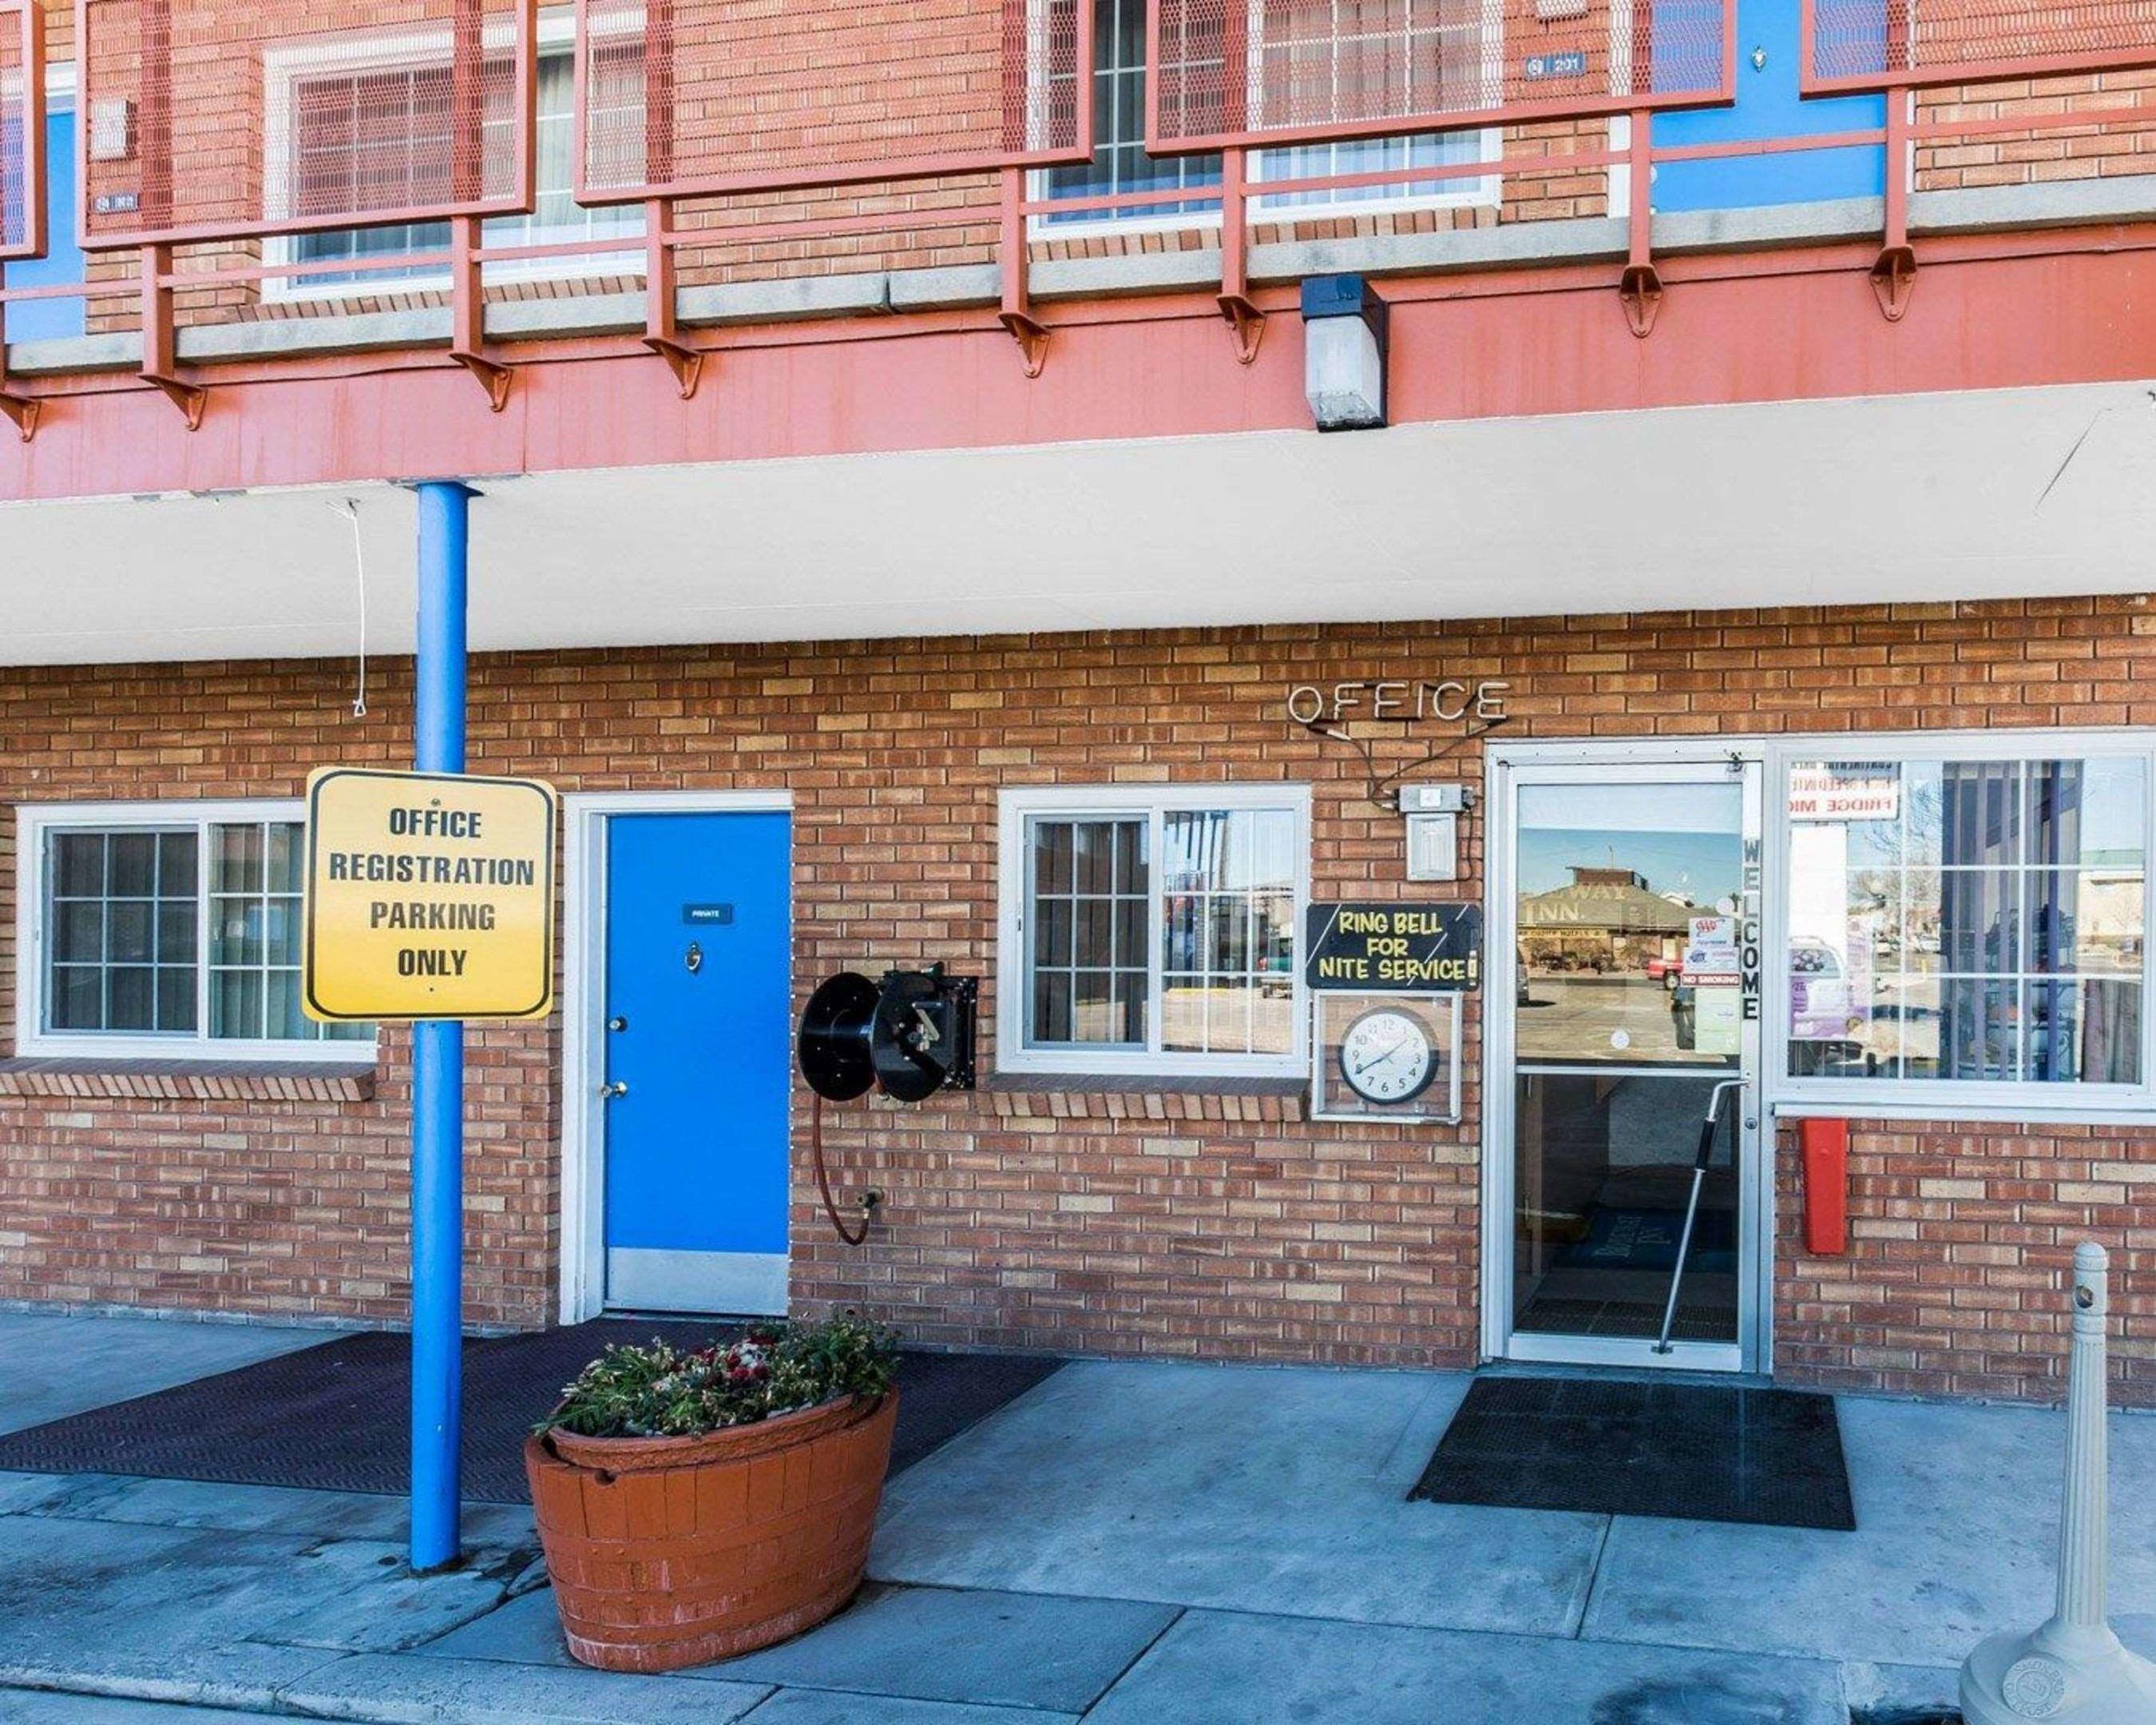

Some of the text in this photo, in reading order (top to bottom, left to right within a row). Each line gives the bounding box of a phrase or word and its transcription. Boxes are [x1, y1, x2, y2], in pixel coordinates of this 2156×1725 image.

[1555, 58, 1578, 72] 201
[1288, 682, 1510, 723] OFFICE
[390, 807, 482, 839] OFFICE
[330, 853, 534, 886] REGISTRATION
[370, 901, 495, 930] PARKING
[1338, 912, 1443, 935] RING BELL
[1742, 839, 1760, 1021] WELCOME
[1366, 937, 1409, 958] FOR
[398, 949, 467, 976] ONLY
[1319, 958, 1466, 981] NITE SERVICE
[1682, 975, 1738, 985] NO SMOKING
[1414, 1054, 1421, 1065] 3
[1367, 1076, 1375, 1087] 7
[1409, 1067, 1417, 1077] 4
[1381, 1082, 1389, 1092] 6
[1398, 1079, 1406, 1090] 5
